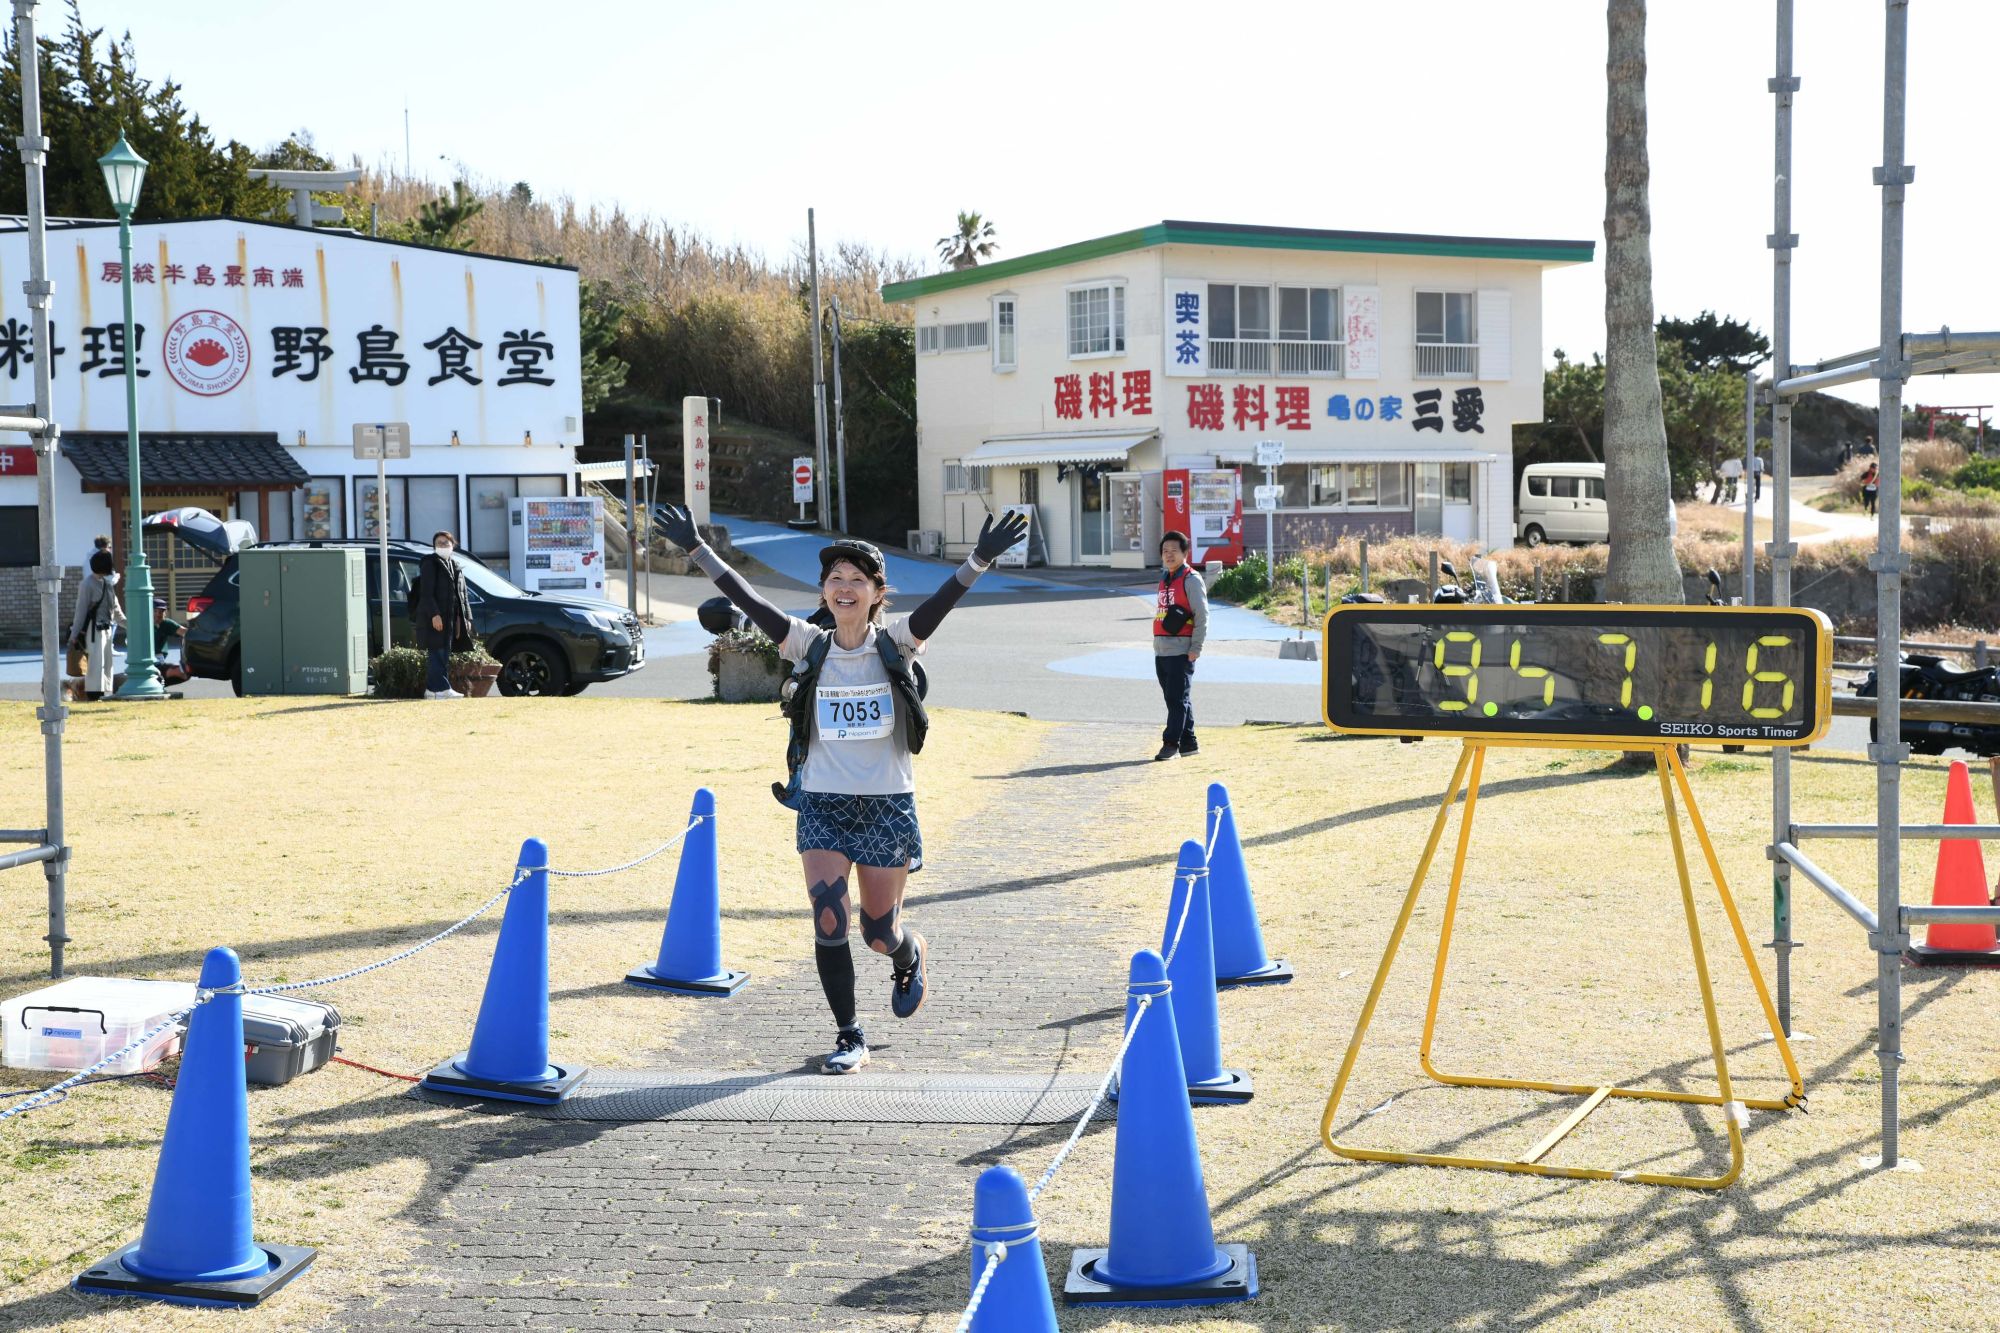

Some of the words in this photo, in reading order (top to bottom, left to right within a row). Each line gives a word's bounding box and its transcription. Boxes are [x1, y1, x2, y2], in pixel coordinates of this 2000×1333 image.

[101, 261, 305, 289] 房総半島最南端
[270, 324, 556, 387] 野島食堂
[177, 367, 204, 390] NOJIMA
[206, 367, 240, 390] SHOKUDO
[1054, 369, 1153, 420] 磯料理
[1186, 383, 1312, 432] 磯料理
[1327, 394, 1403, 422] 亀の家
[1411, 386, 1485, 434] 三愛
[829, 700, 881, 722] 7053
[1660, 722, 1713, 735] SEIKO
[1717, 724, 1758, 737] Sports
[1761, 726, 1799, 737] Timer
